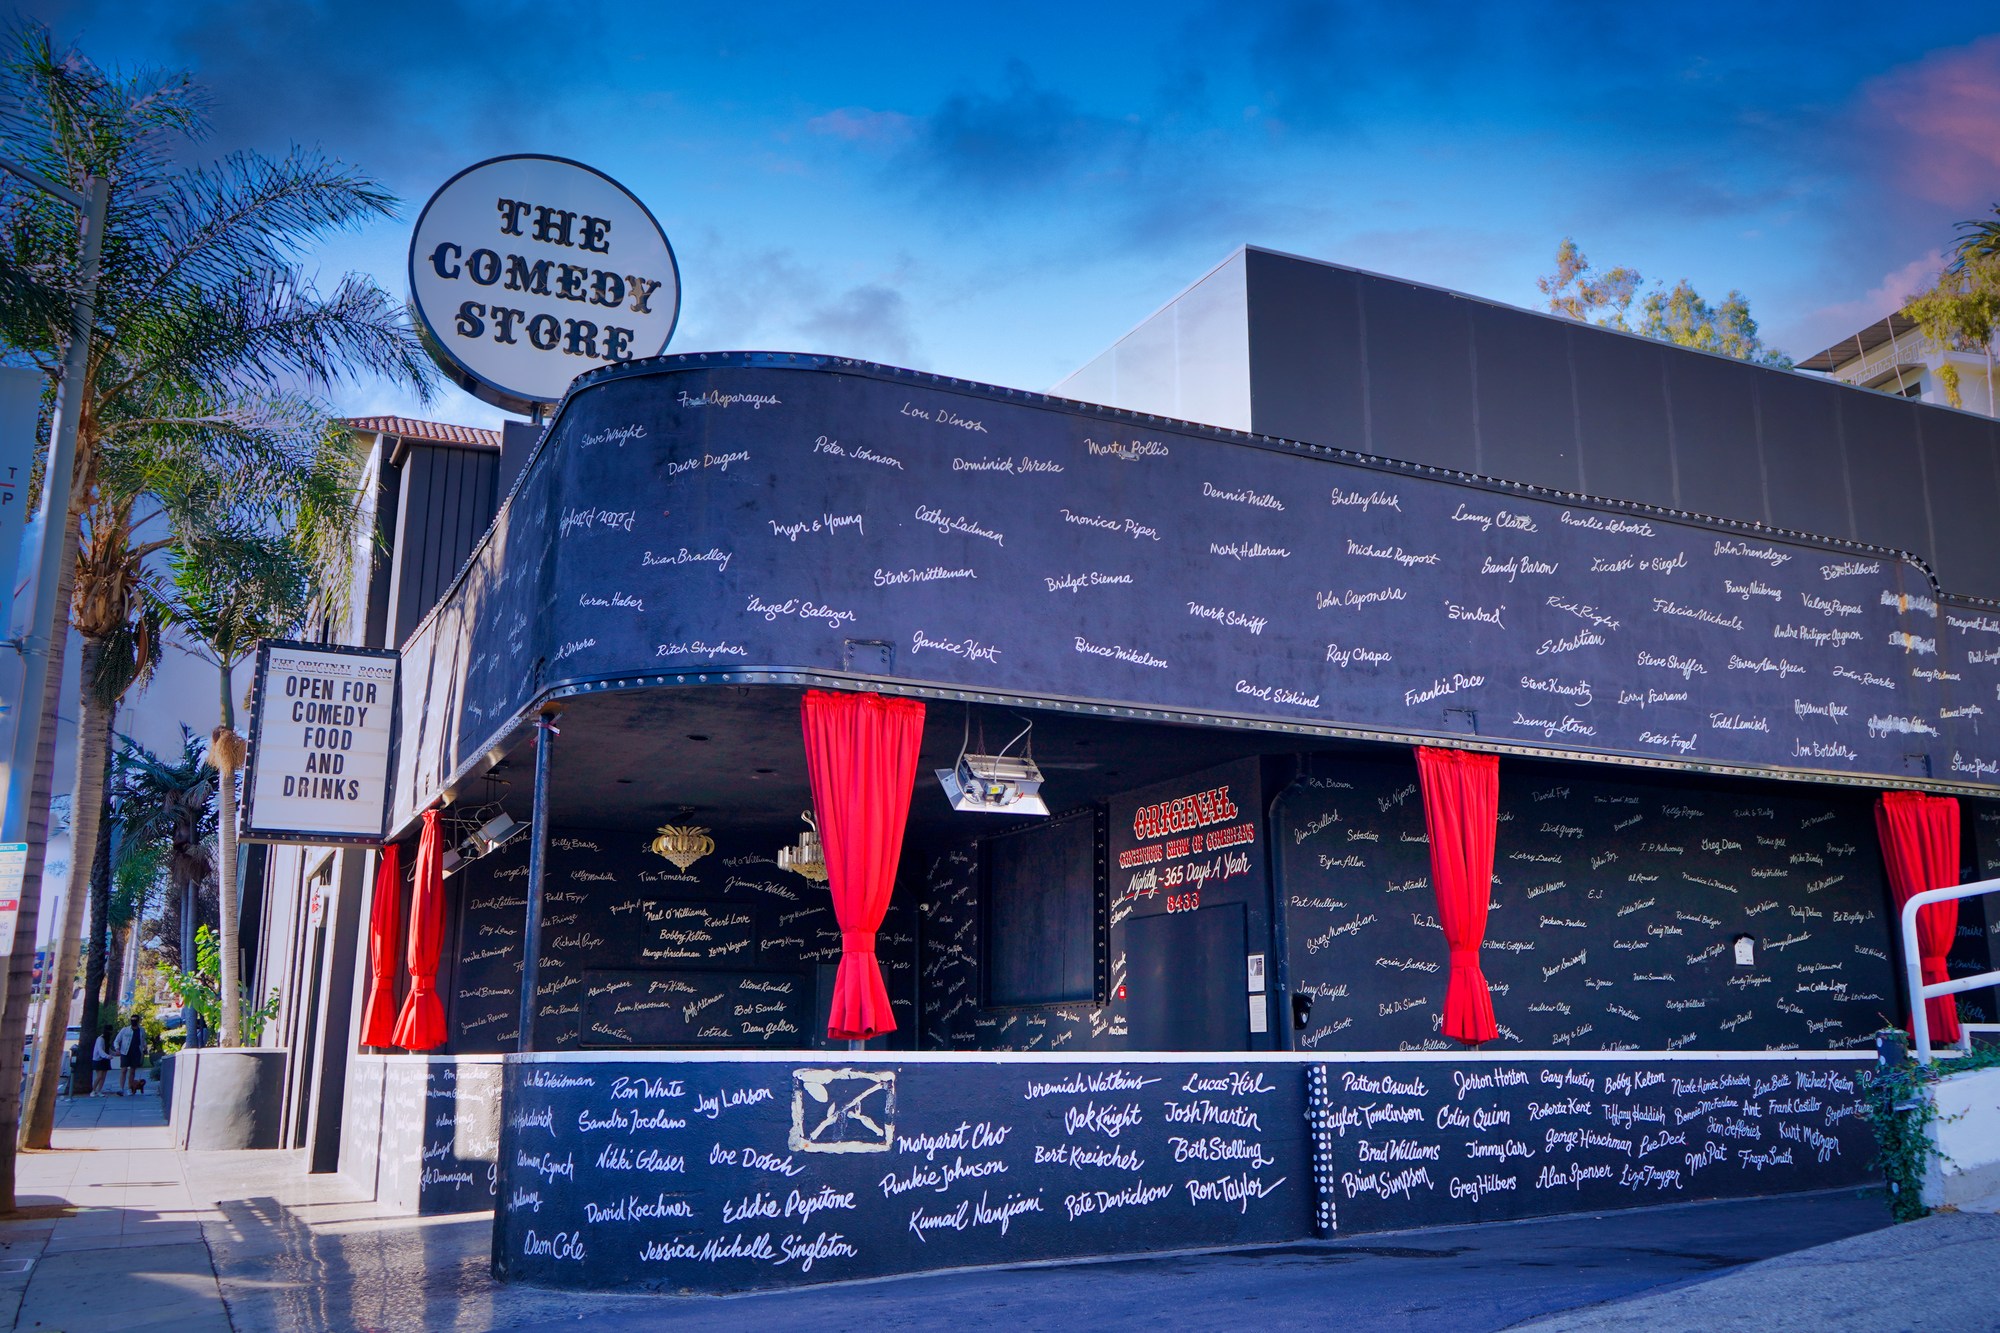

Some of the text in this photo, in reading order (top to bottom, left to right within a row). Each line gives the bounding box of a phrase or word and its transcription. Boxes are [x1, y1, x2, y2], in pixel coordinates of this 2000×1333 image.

[497, 198, 611, 254] THE
[429, 242, 661, 314] COMEDY
[455, 300, 634, 363] STORE
[602, 424, 647, 448] Wright
[668, 450, 750, 475] Dave Dugan
[813, 435, 904, 470] Peter Johnson
[953, 456, 1014, 475] Dominick
[1203, 482, 1285, 511] Dennis Miller
[768, 520, 810, 541] Myer
[823, 513, 864, 535] Young
[915, 504, 1004, 547] Cathy Ladman
[1060, 509, 1160, 541] Monica Piper
[642, 548, 732, 571] Brian Bradley
[1210, 542, 1241, 560] Mark
[1714, 540, 1792, 566] John Mendoza
[874, 566, 978, 587] Steve Mittleman
[1481, 556, 1559, 583] Sandy Baron
[580, 592, 644, 611] Karen Haber
[1316, 587, 1407, 610] John Caponera
[800, 602, 856, 628] Salazar
[1187, 601, 1268, 635] Mark Schiff
[656, 641, 748, 658] Ritch Shydner
[911, 630, 1002, 663] Janice Hart
[1326, 643, 1392, 667] Ray Chapa
[1536, 629, 1605, 655] Sebastian
[1637, 651, 1708, 680] Steve Shaffer
[286, 676, 377, 704] OPEN FOR
[1235, 679, 1320, 708] Carol Siskind
[1405, 673, 1485, 706] Frankie Pace
[292, 701, 368, 727] COMEDY
[1512, 712, 1598, 737] Danny Stone
[1710, 712, 1770, 733] Todd Lemisch
[303, 727, 352, 750] FOOD
[305, 752, 344, 774] AND
[1951, 751, 1977, 771] Steve
[283, 775, 359, 800] DRINKS
[1133, 785, 1238, 840] ORIGINAL
[1166, 837, 1190, 860] SHOW
[1192, 834, 1203, 853] OF
[1537, 853, 1562, 864] David
[1127, 867, 1158, 901] Nightly
[1186, 861, 1211, 889] Days
[1211, 857, 1220, 878] A
[1224, 852, 1252, 879] Year
[763, 880, 800, 900] Walker
[1167, 891, 1199, 913] 8433
[1290, 895, 1348, 909] Pat Mulligan
[731, 914, 751, 924] Love
[1297, 980, 1350, 1001] Jerry Seinfeld
[697, 1027, 733, 1038] Lotus
[741, 1021, 764, 1034] Dean
[611, 1077, 686, 1099] Ron White
[1024, 1069, 1162, 1100] Jeremiah Watkins
[1341, 1072, 1429, 1096] Patton Oswalt
[1604, 1071, 1665, 1096] Bobby Kelton
[1795, 1070, 1827, 1091] Michael
[694, 1086, 773, 1119] Jay Larson
[1164, 1100, 1261, 1132] Josh Martin
[1437, 1104, 1511, 1131] Colin Quinn
[1602, 1104, 1665, 1129] Tiffany Haddish
[897, 1120, 1012, 1160] Margaret Cho
[1168, 1137, 1274, 1169] Beth Stelling
[1358, 1140, 1441, 1162] Brad Williams
[1465, 1140, 1536, 1163] Jimmy Carr
[596, 1144, 686, 1173] Nikki Glaser
[1034, 1143, 1144, 1171] Bert Kreischer
[1685, 1141, 1727, 1176] Ms Pat
[879, 1156, 1008, 1198] Punkie Johnson
[1341, 1166, 1434, 1200] Brian Simpson
[1449, 1174, 1517, 1202] Greg Hilbers
[1536, 1165, 1567, 1189] Alan
[723, 1185, 856, 1224] Eddie Pepitone
[1064, 1180, 1173, 1222] Pete Davidson
[1186, 1172, 1287, 1214] Ron Taylor
[584, 1193, 694, 1223] David Koechner
[908, 1187, 1044, 1243] Kumail Nanjiani
[640, 1231, 857, 1272] Jessica Michelle Singleton
